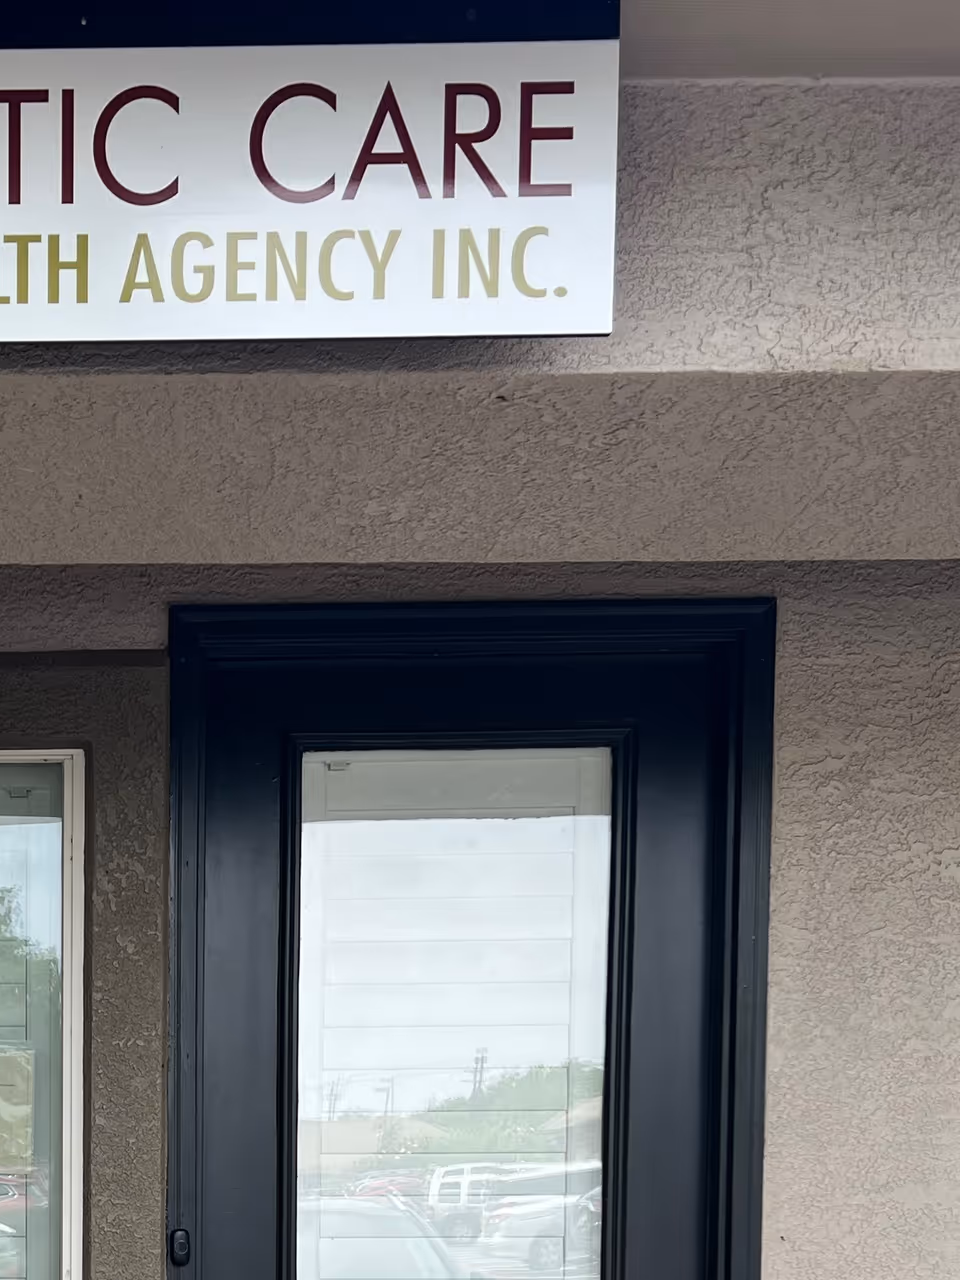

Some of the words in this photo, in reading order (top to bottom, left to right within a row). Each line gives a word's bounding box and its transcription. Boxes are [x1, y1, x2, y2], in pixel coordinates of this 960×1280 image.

[249, 80, 576, 203] CARE
[120, 228, 402, 304] AGENCY
[429, 225, 569, 300] INC.
